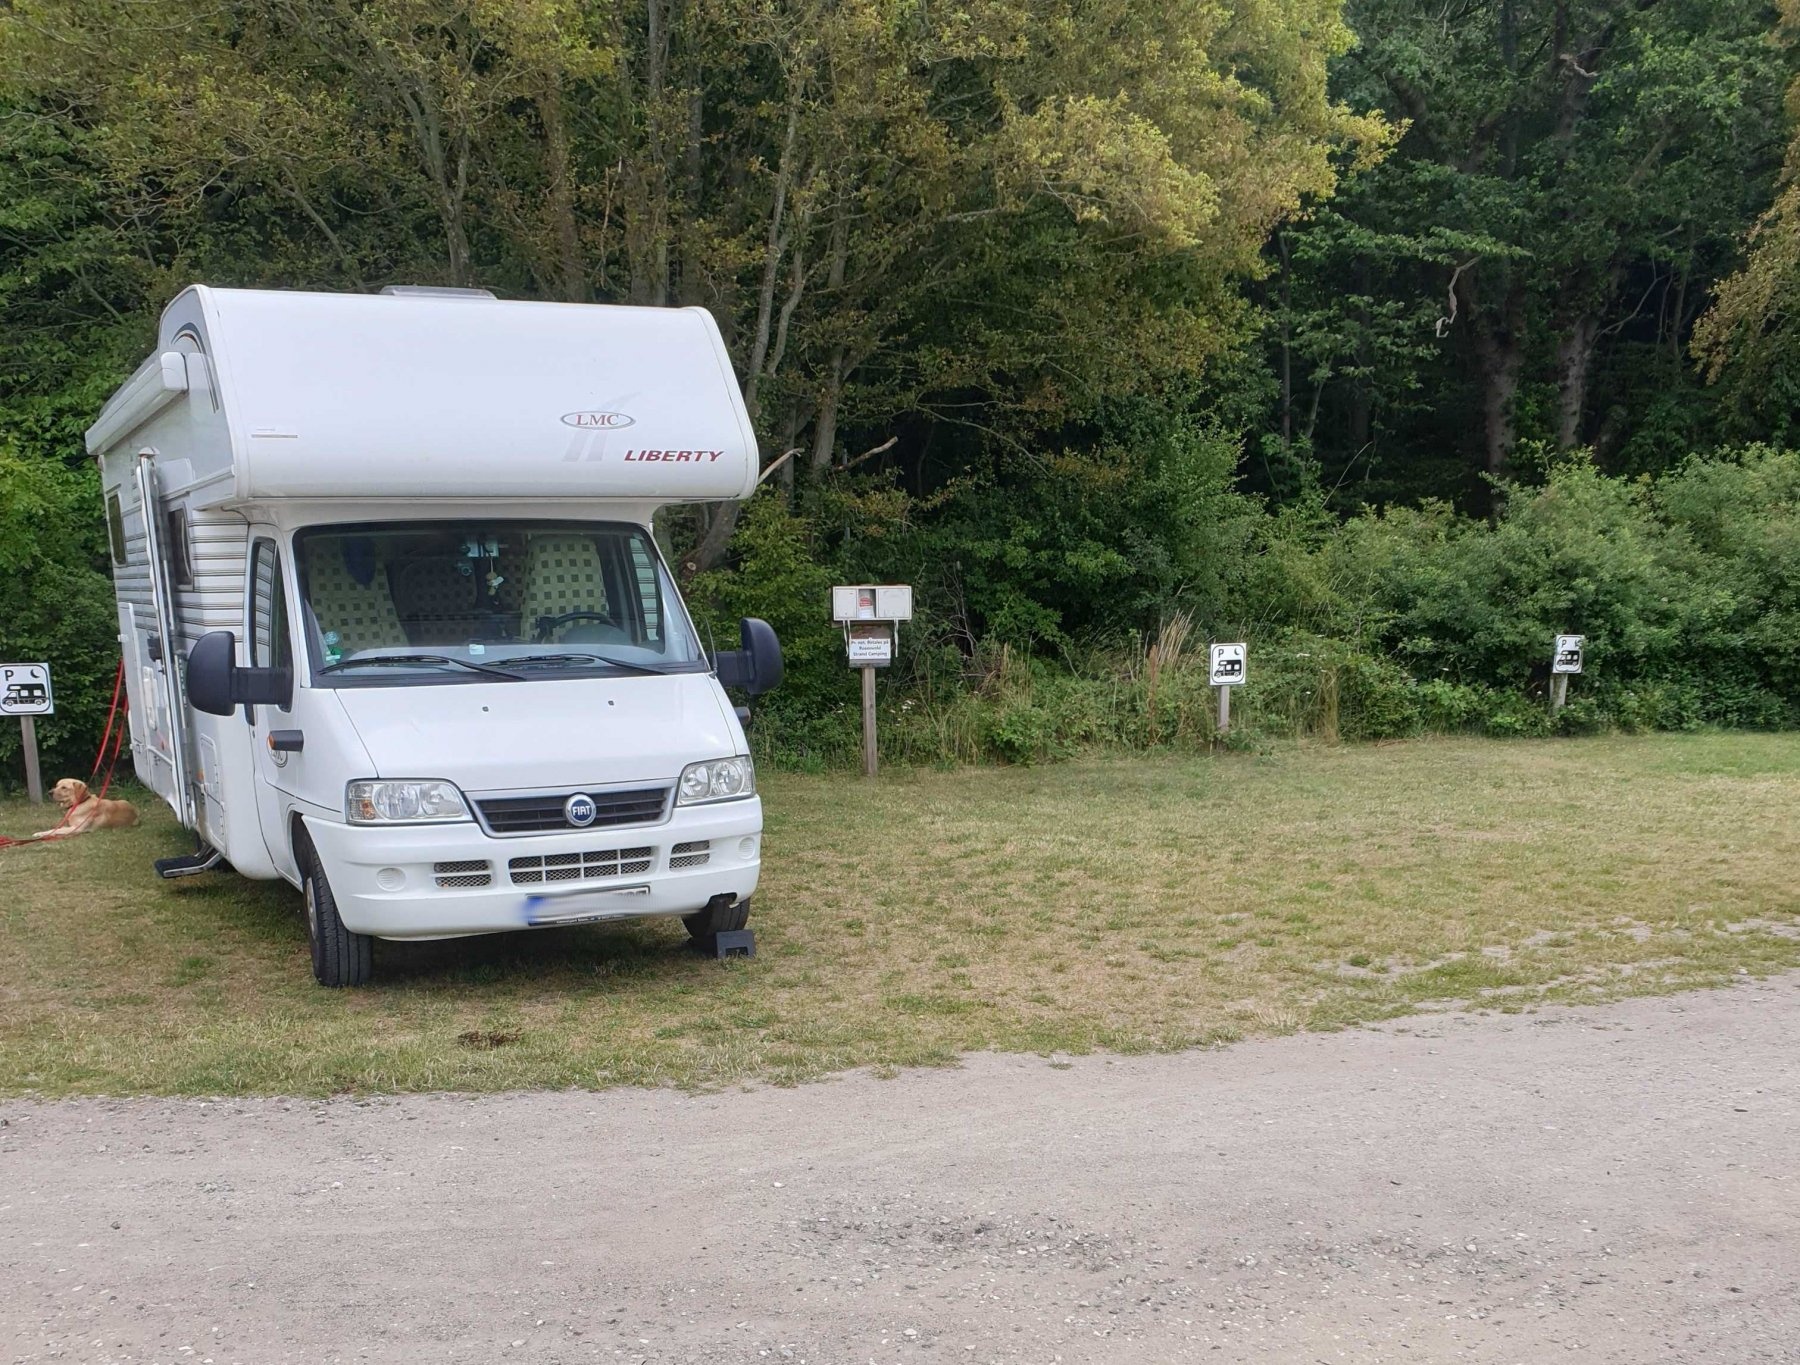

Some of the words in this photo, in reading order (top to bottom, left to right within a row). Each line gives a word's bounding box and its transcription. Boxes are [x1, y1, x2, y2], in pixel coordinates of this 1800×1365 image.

[576, 414, 619, 426] LMC
[624, 450, 724, 462] LIBERTY
[1561, 640, 1567, 648] P
[1218, 649, 1224, 658] P
[4, 669, 14, 681] P
[572, 805, 591, 817] FIAT
